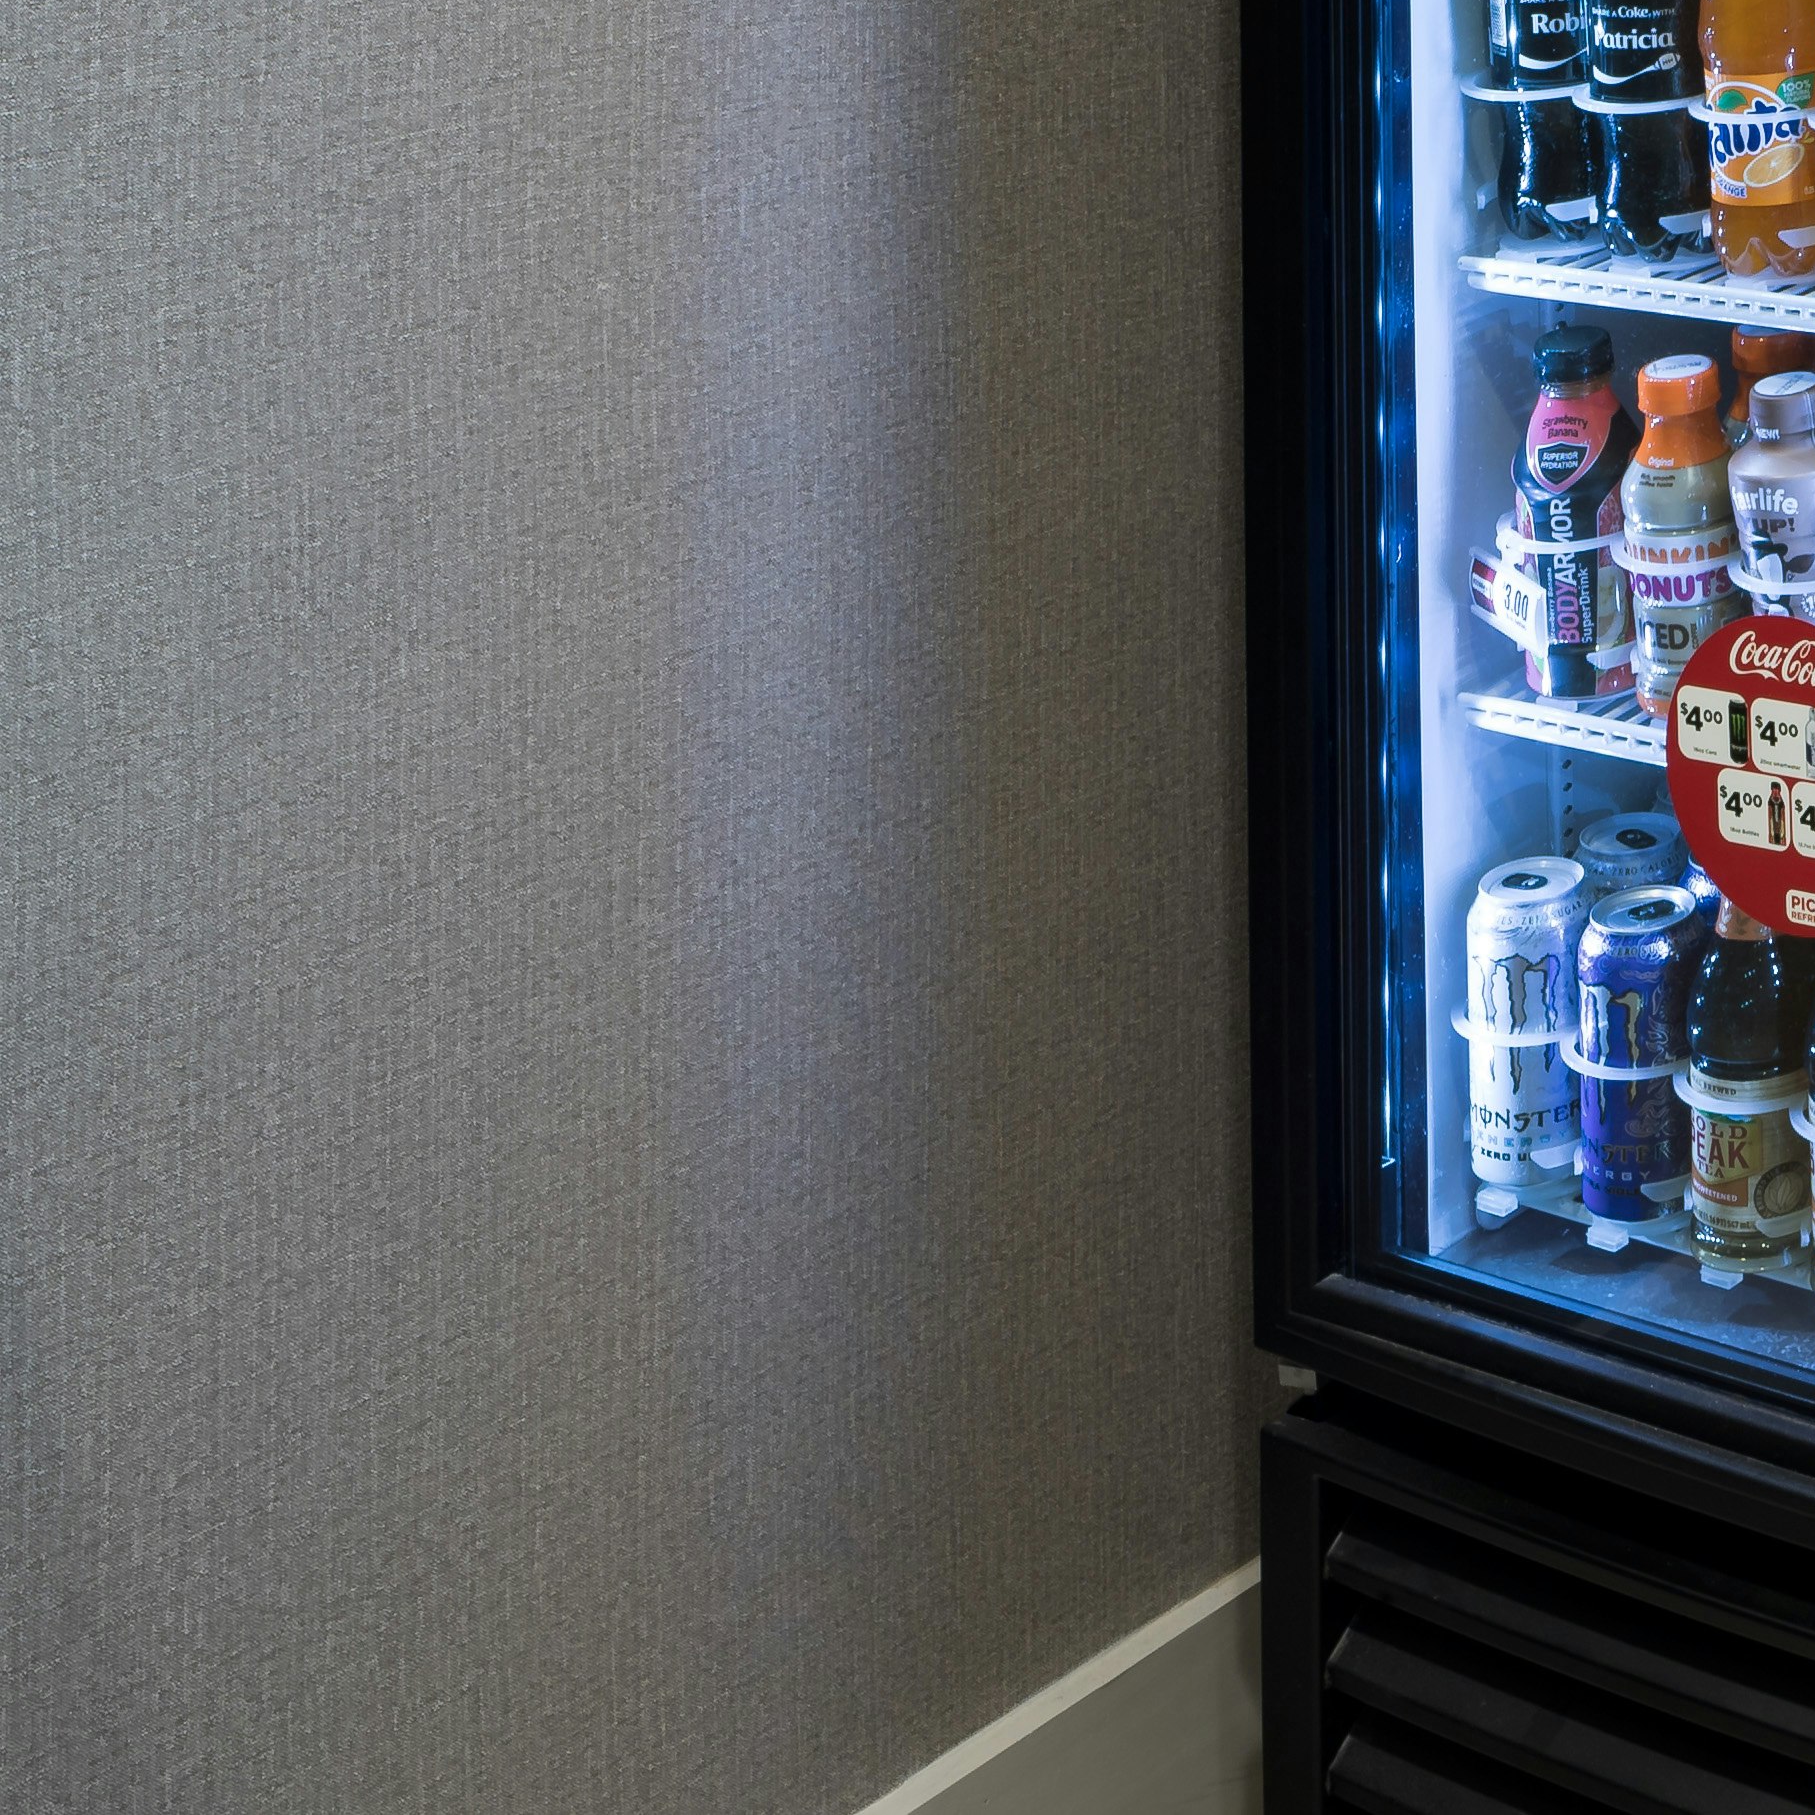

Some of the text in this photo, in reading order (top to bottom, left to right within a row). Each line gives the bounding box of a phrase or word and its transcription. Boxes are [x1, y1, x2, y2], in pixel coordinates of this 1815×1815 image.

[1593, 25, 1675, 49] Patricia
[1542, 415, 1588, 431] Strawberry
[1648, 458, 1674, 466] Original
